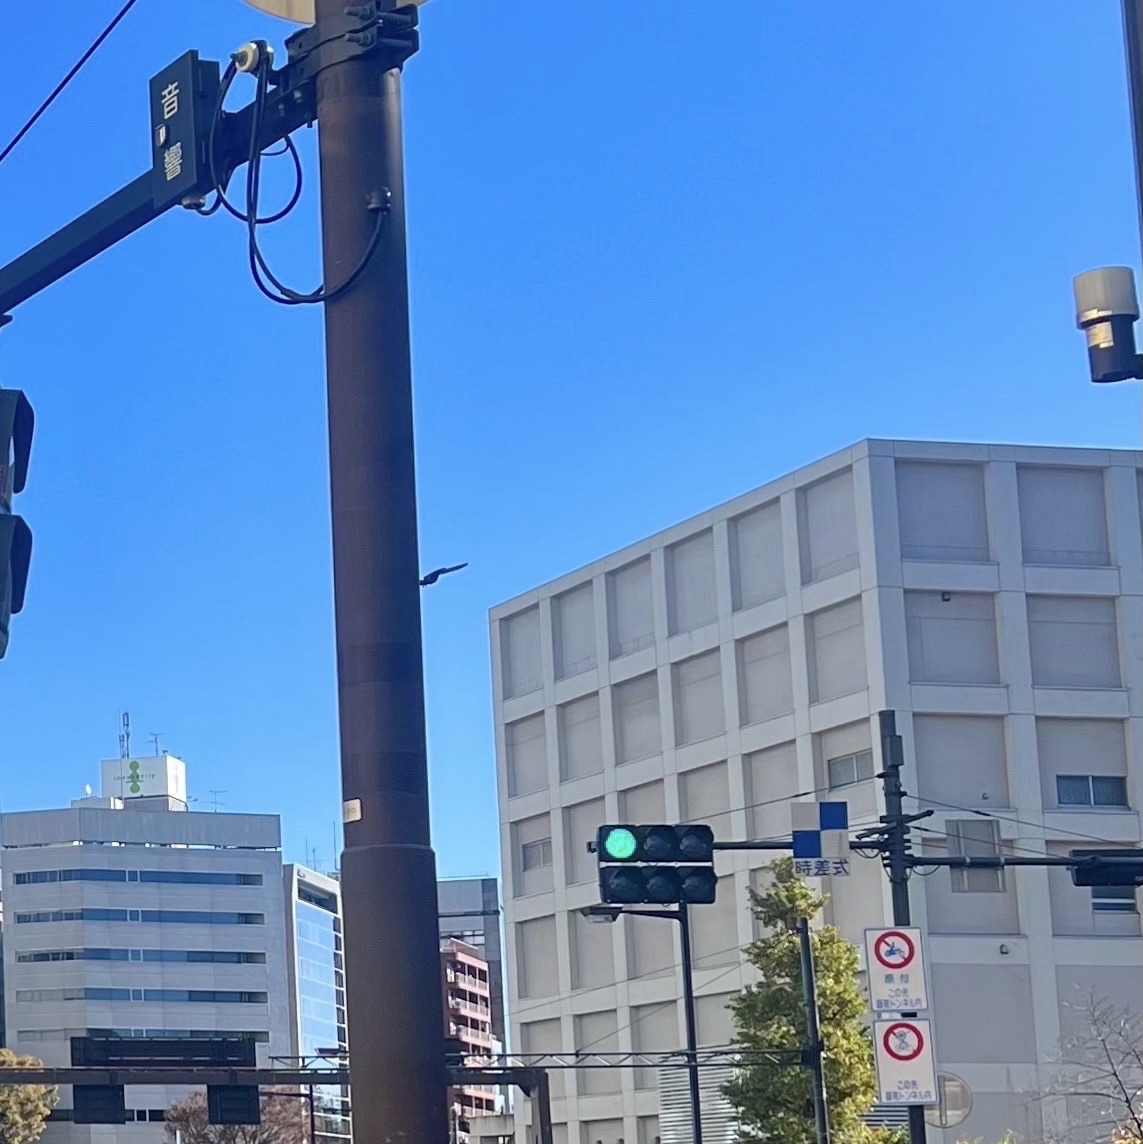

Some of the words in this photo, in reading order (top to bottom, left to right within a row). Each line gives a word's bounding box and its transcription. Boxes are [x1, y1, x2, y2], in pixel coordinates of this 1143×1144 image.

[161, 81, 183, 181] 音響
[796, 860, 849, 876] 時差式
